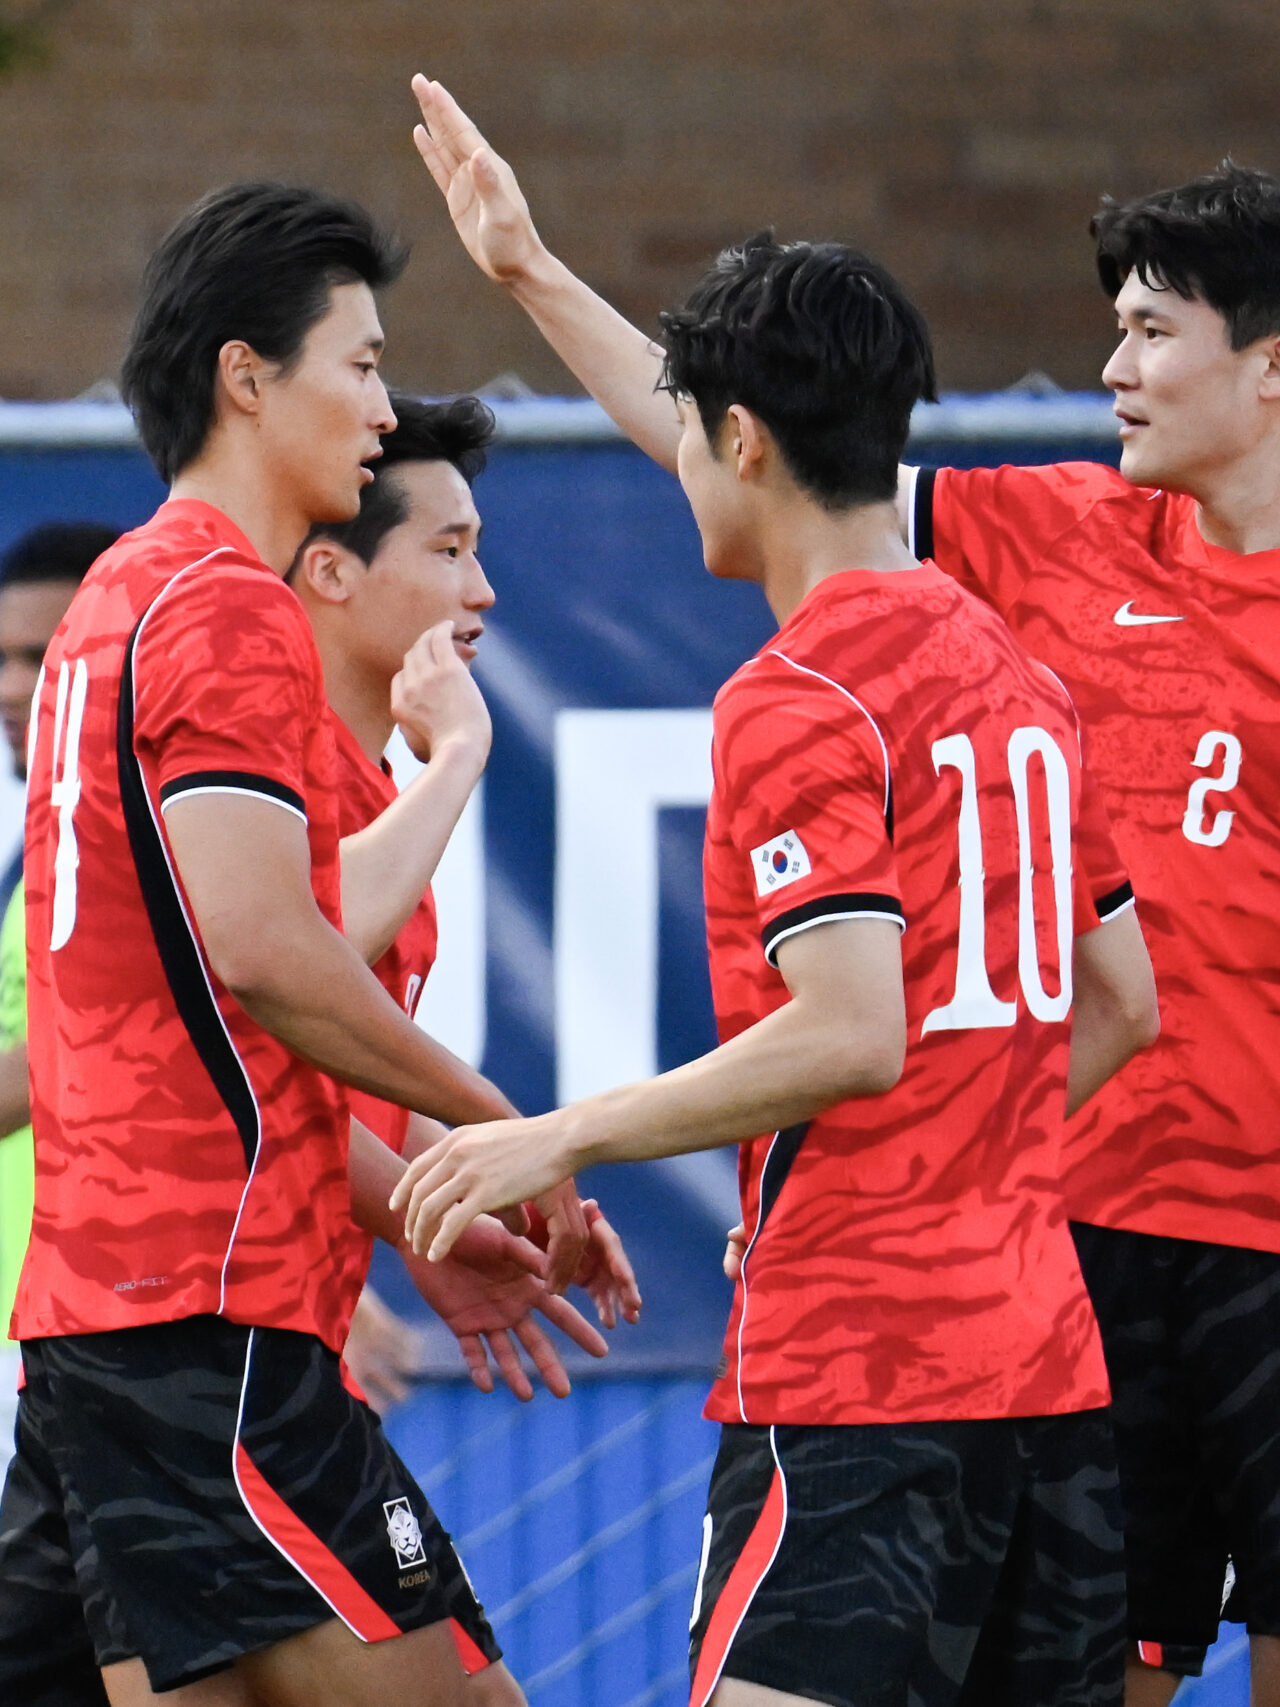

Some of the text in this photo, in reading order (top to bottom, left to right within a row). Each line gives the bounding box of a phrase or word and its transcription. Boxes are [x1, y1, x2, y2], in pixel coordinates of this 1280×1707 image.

[26, 658, 87, 950] 4
[920, 726, 1074, 1040] 10
[1182, 730, 1242, 847] 2
[398, 1570, 431, 1589] KOREA
